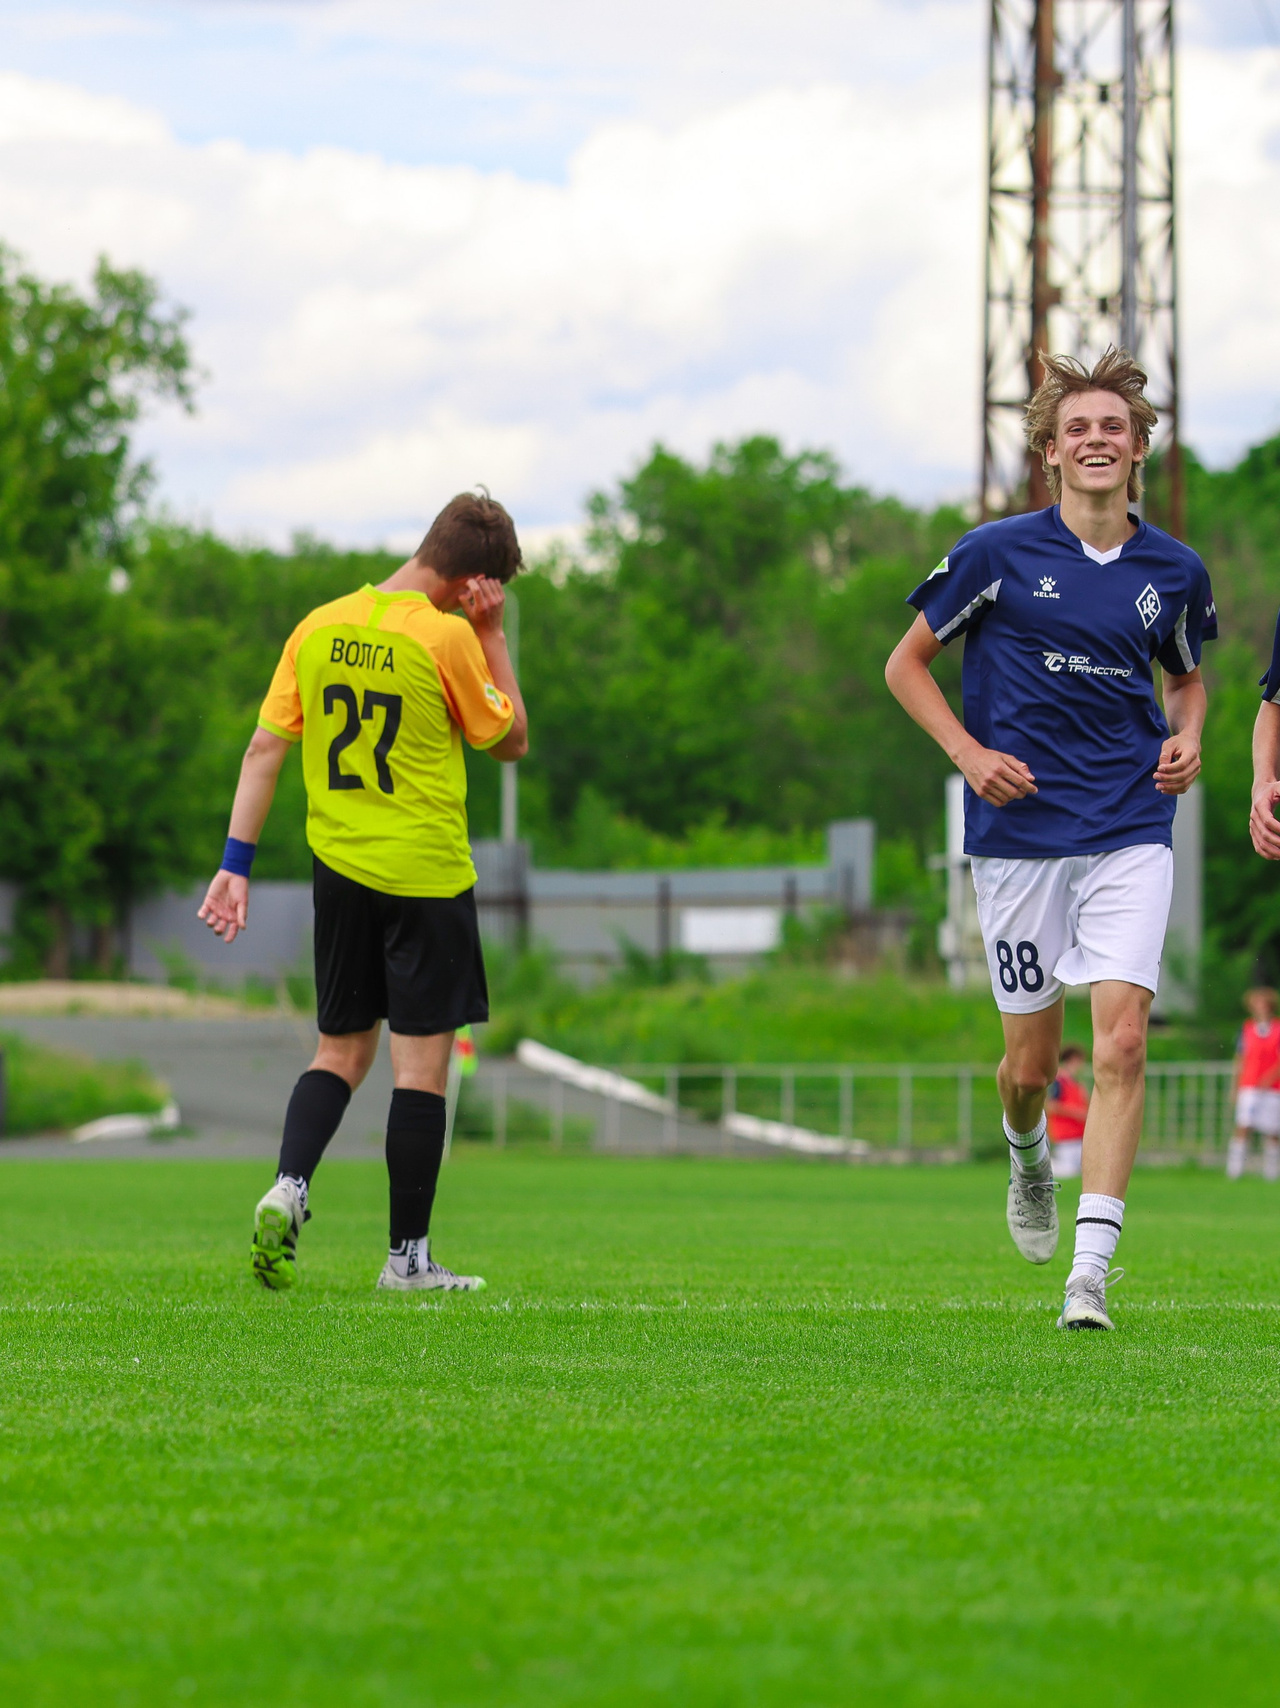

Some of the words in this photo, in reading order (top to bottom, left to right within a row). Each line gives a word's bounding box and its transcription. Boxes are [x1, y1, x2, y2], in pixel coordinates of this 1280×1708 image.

[1033, 591, 1060, 599] KELME
[330, 638, 394, 672] ВОЛГА
[1068, 655, 1091, 664] ДСК
[323, 684, 403, 794] 27
[996, 940, 1044, 993] 88
